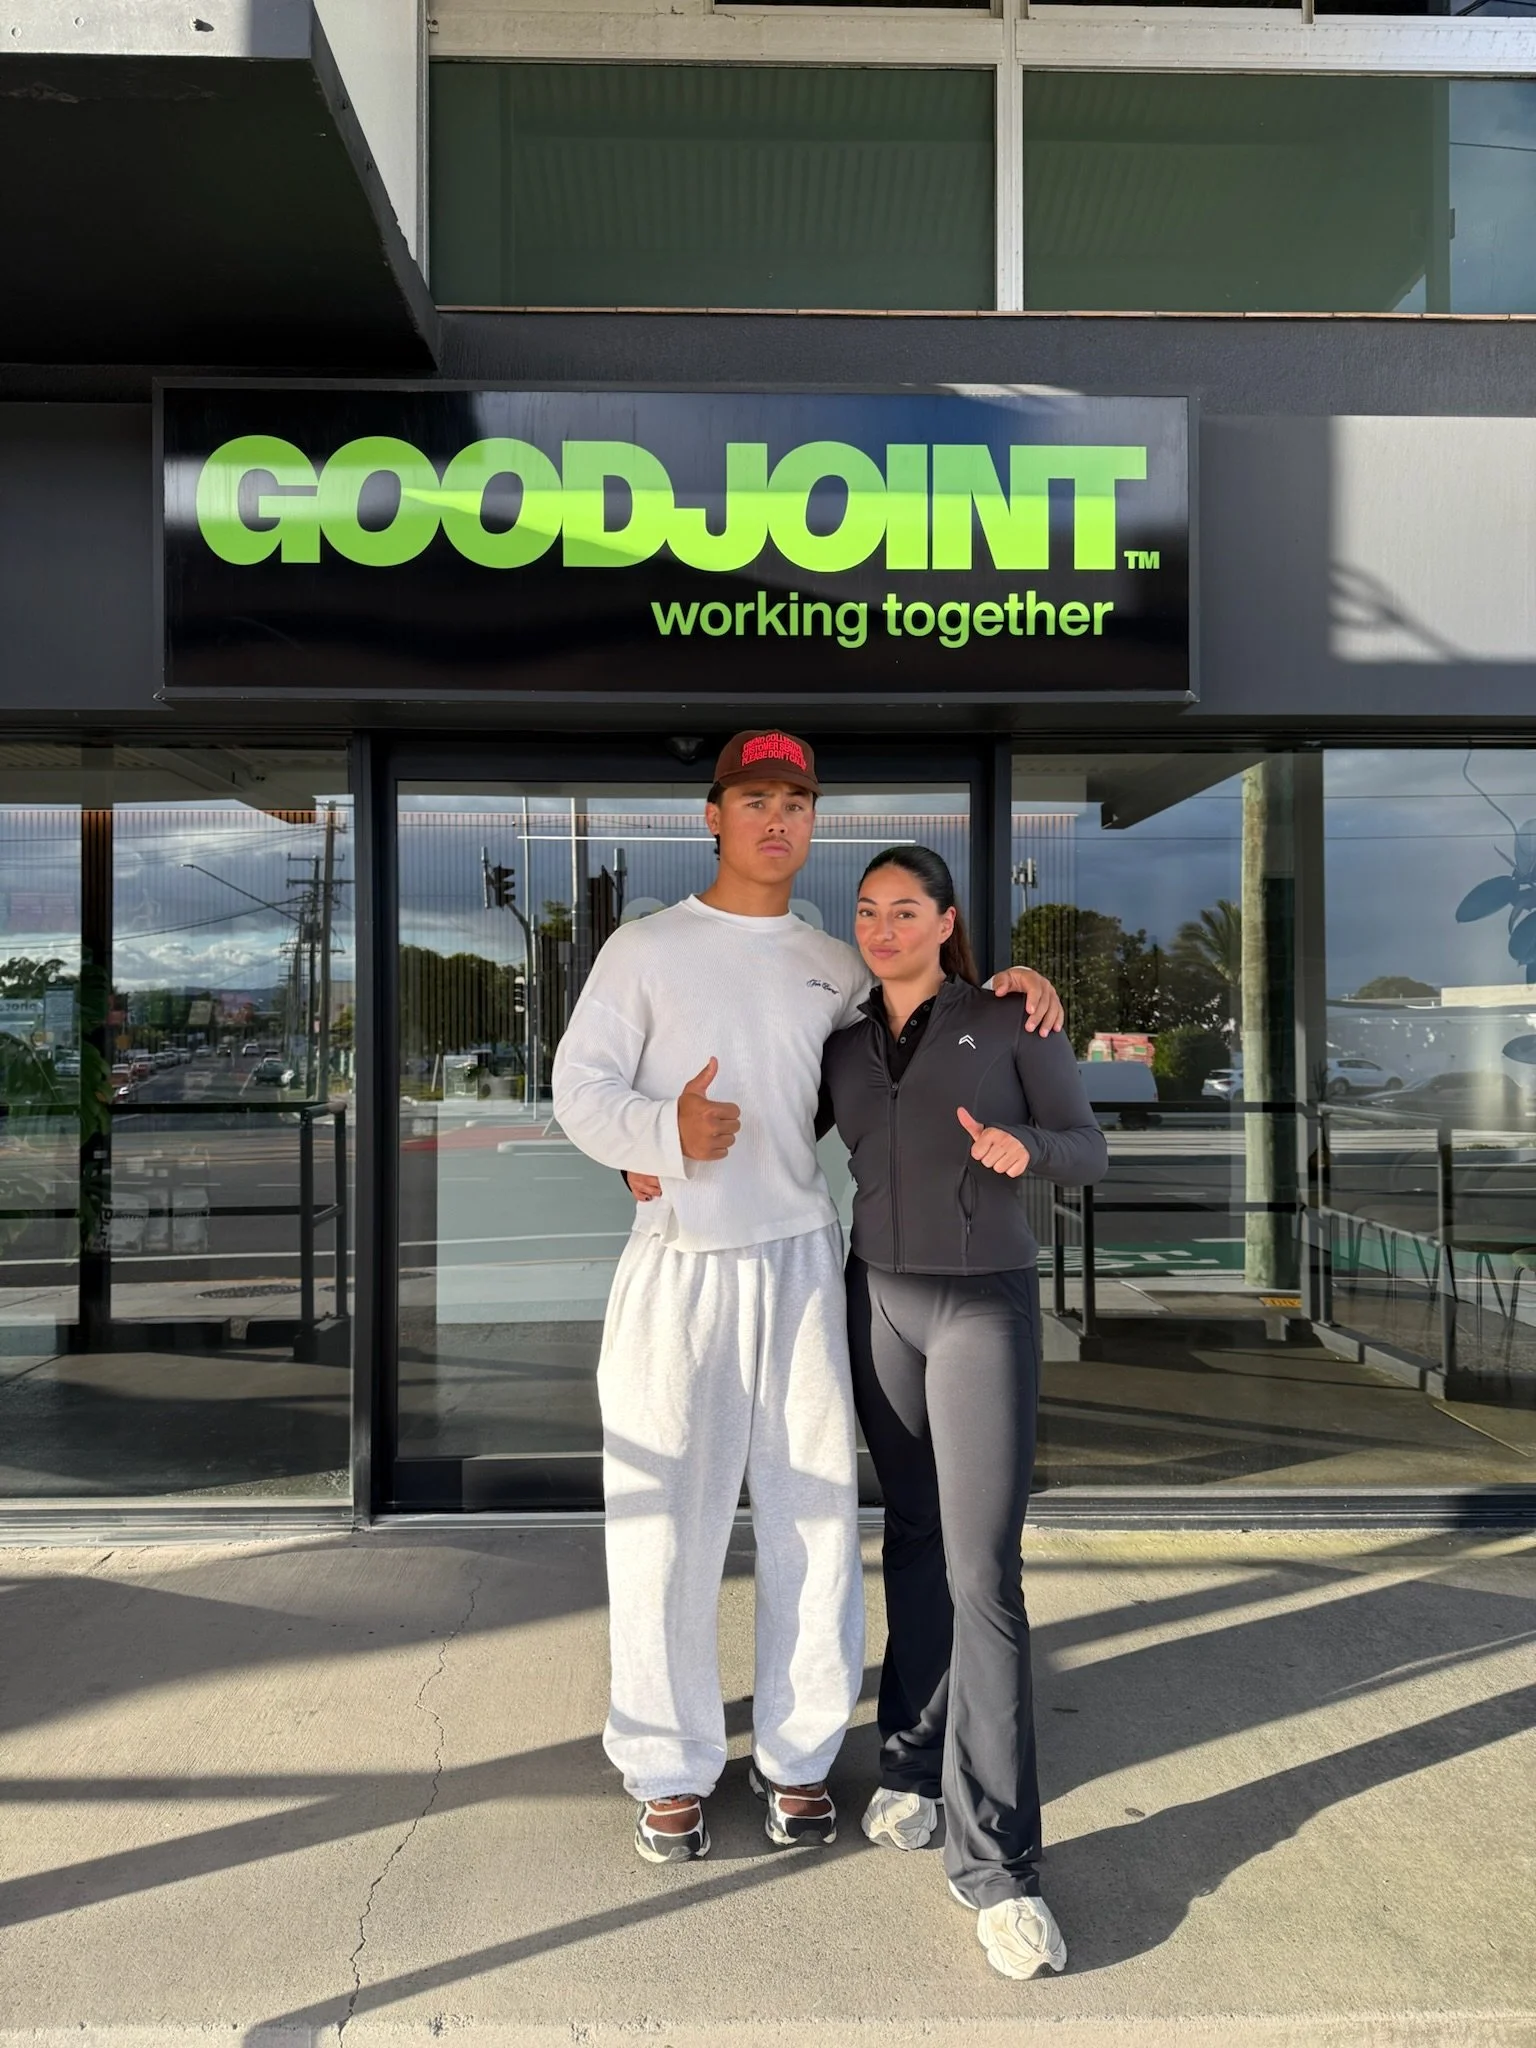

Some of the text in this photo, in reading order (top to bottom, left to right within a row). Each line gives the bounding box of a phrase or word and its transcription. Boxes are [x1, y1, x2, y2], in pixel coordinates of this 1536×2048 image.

[1124, 551, 1161, 569] TM
[651, 590, 1114, 649] working together
